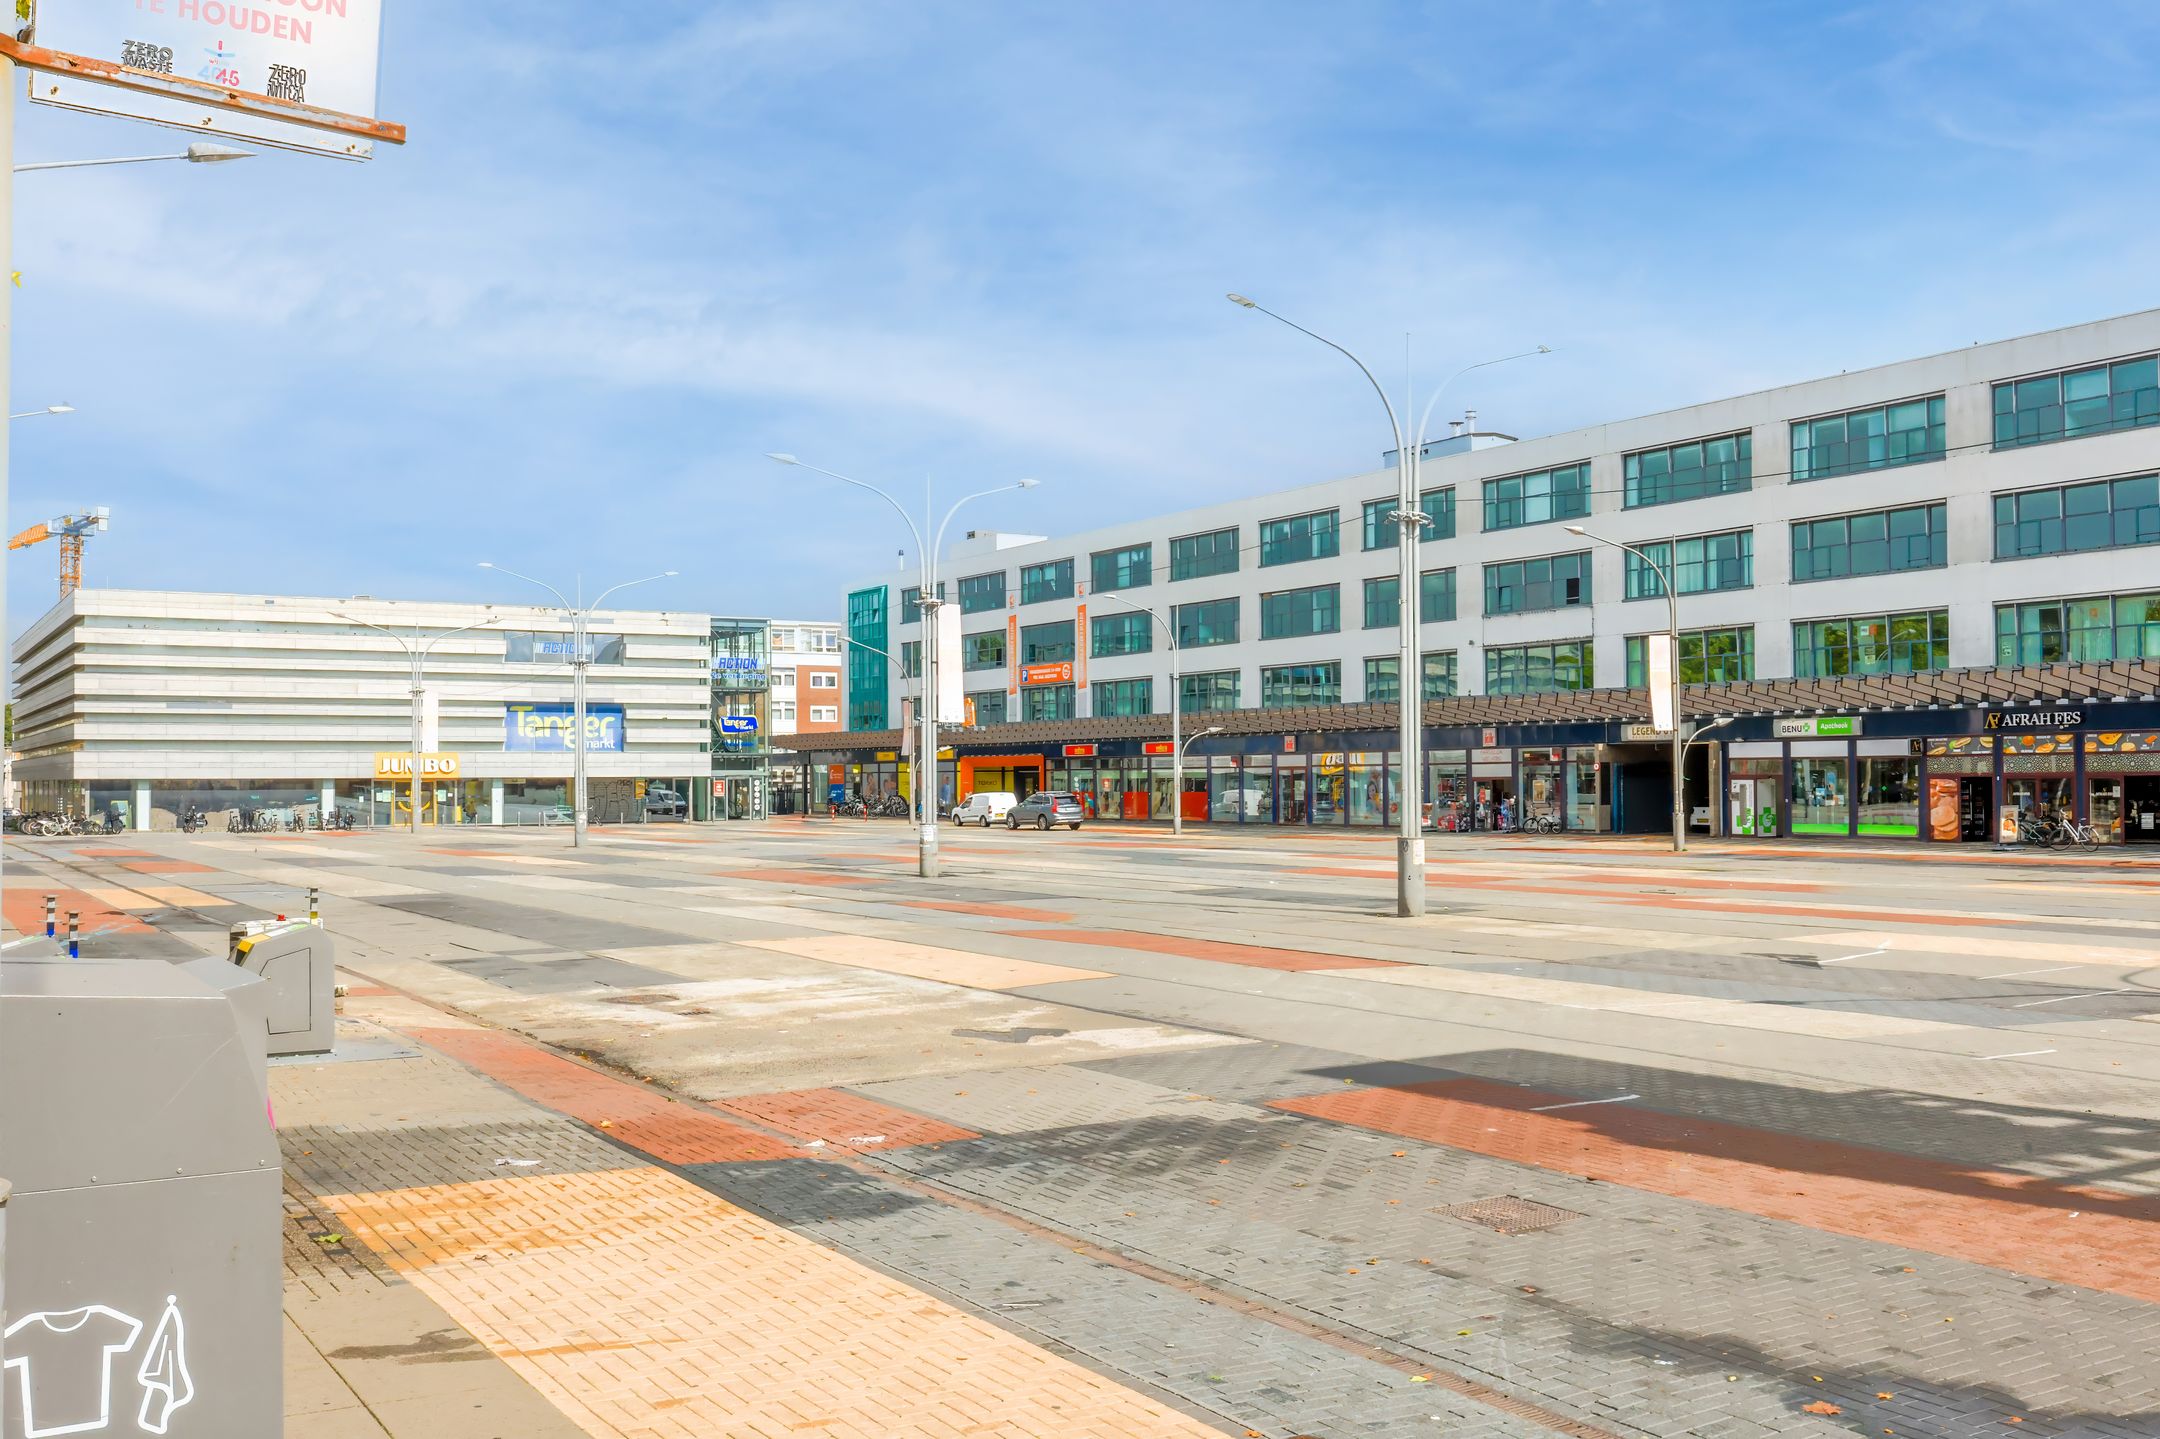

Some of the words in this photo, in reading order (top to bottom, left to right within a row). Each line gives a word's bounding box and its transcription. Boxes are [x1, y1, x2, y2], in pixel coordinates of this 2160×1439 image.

[178, 0, 312, 44] HOUDEN
[121, 39, 173, 61] ZERO
[120, 55, 173, 73] WASTE
[268, 63, 306, 87] ZERO
[543, 641, 578, 654] ACTIO
[718, 657, 758, 669] ACTION
[2002, 712, 2051, 727] AFRAH
[2054, 711, 2081, 725] FES
[1781, 725, 1802, 733] BENU
[584, 735, 615, 749] markt
